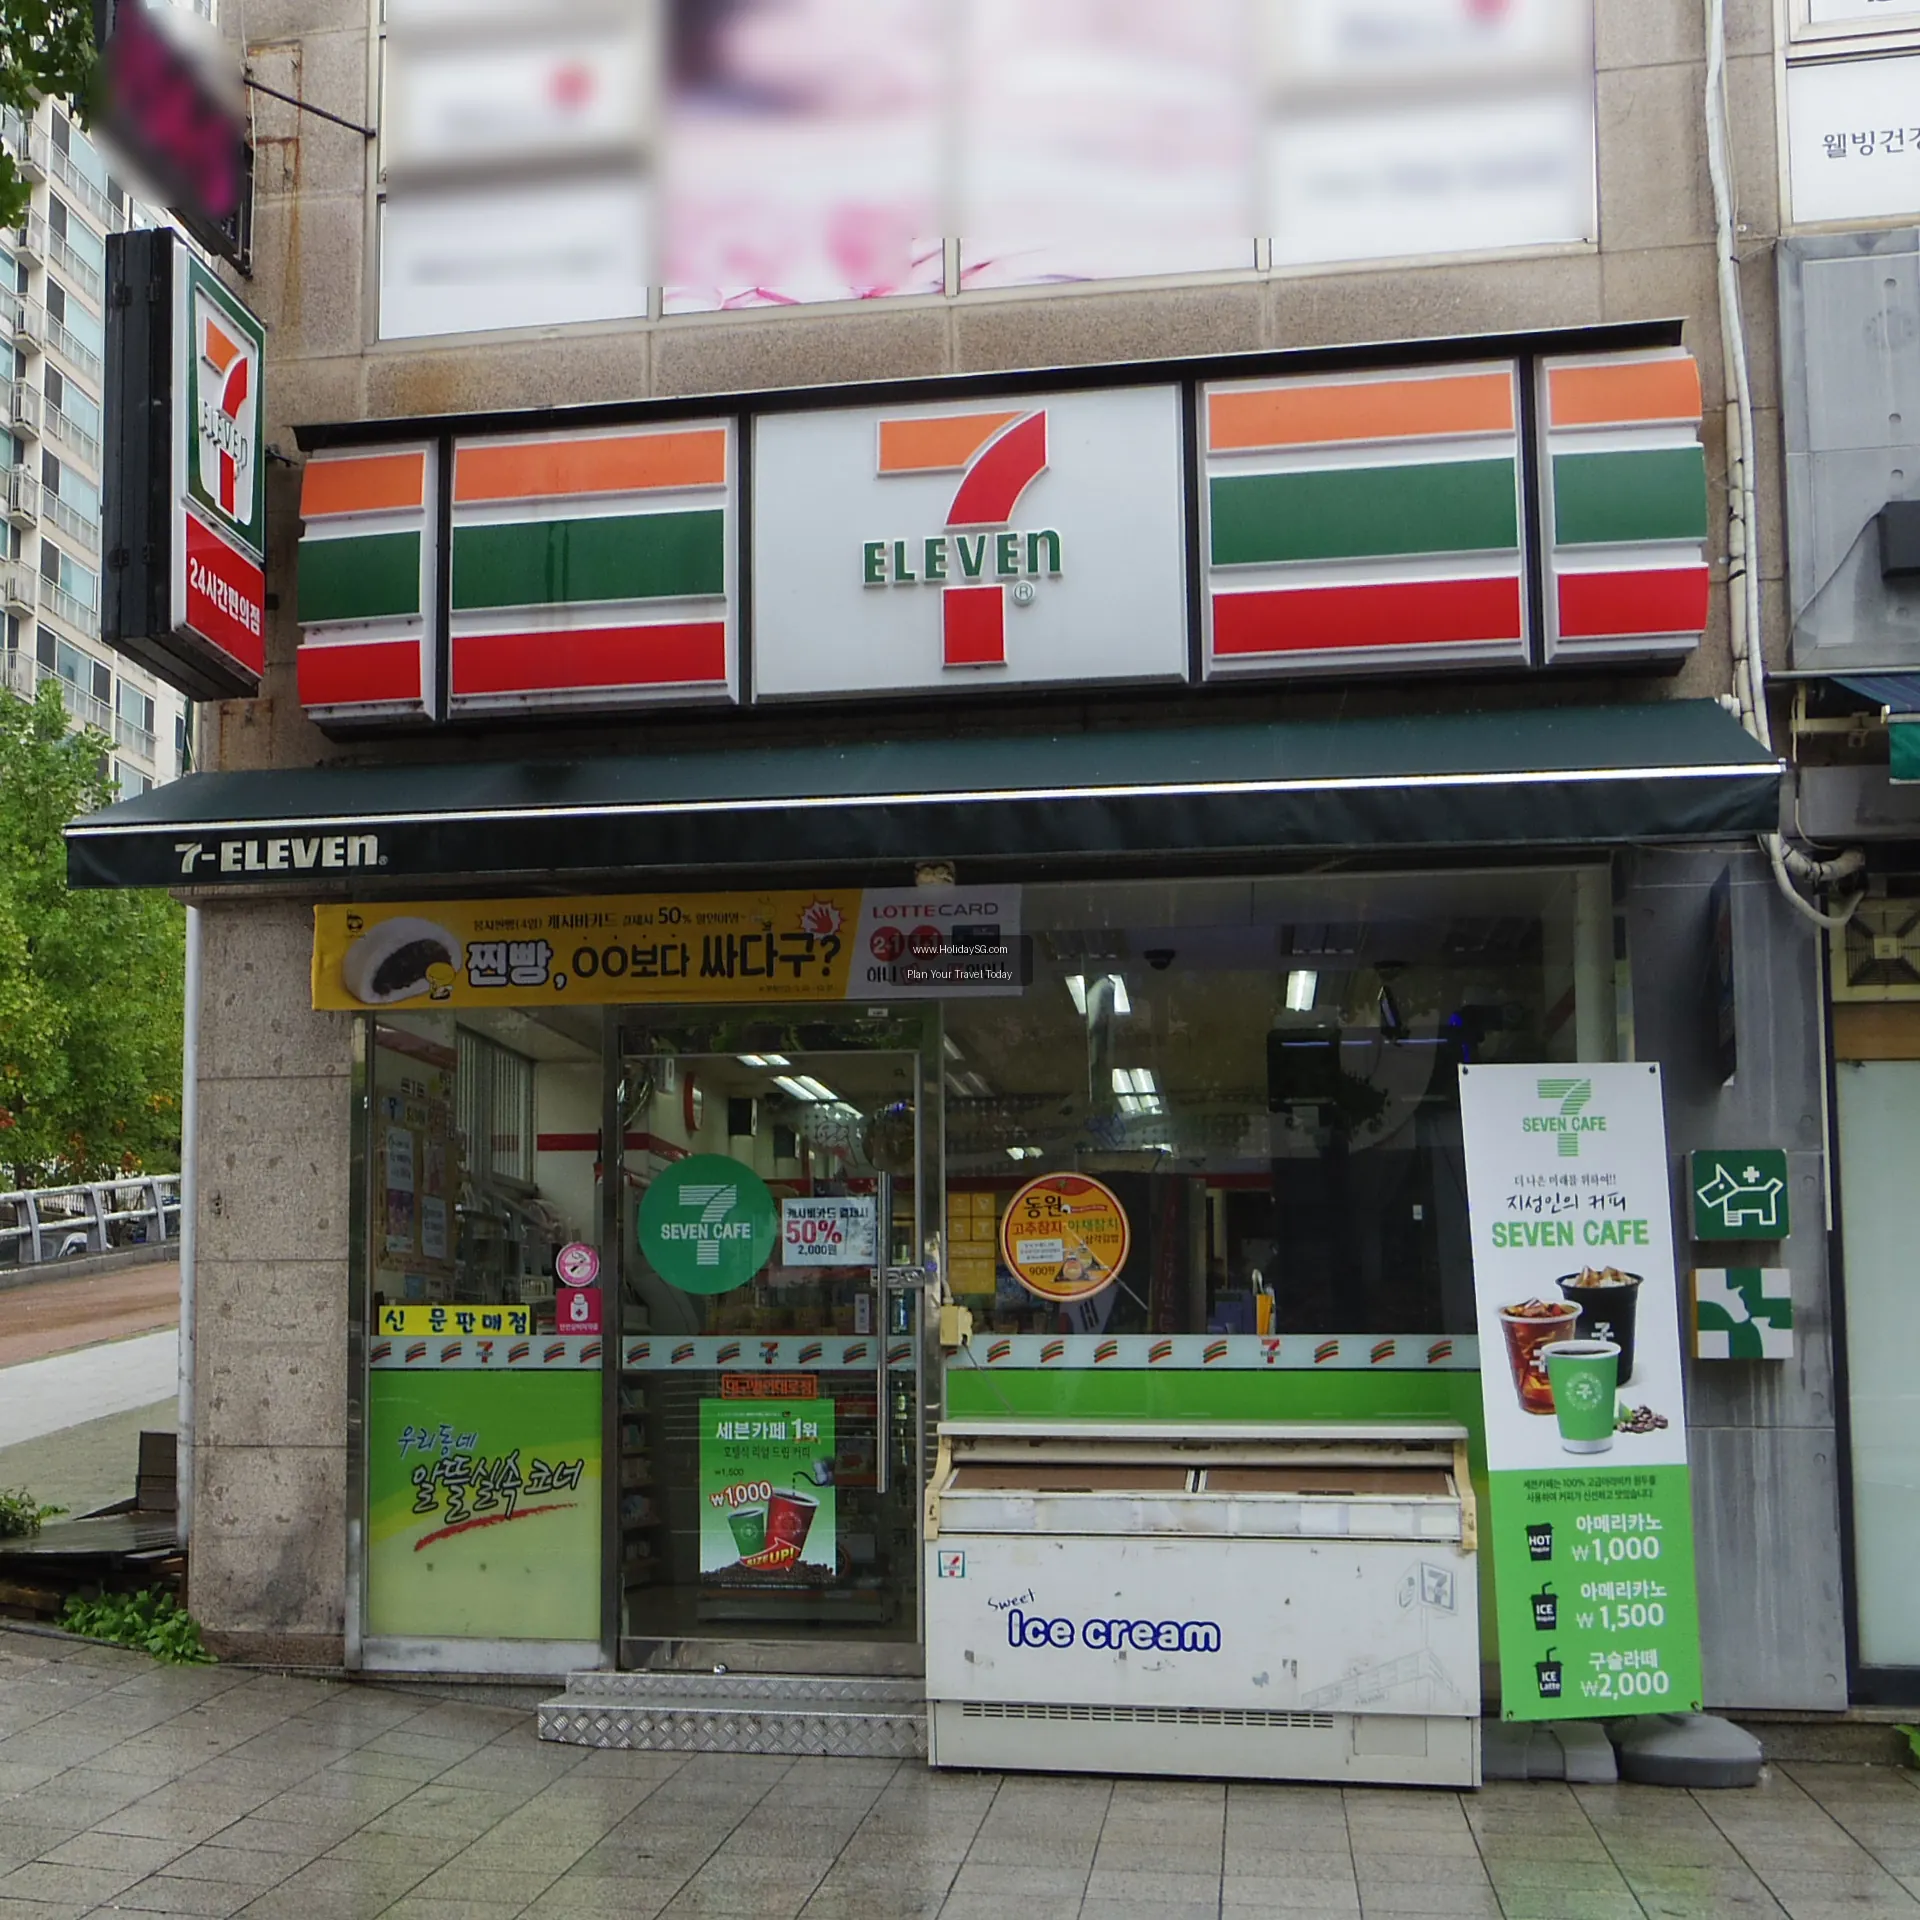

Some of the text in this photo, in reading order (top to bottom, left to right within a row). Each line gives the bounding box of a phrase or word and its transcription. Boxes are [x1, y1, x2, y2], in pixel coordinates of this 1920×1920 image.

[877, 410, 1049, 667] 7
[190, 557, 261, 637] 24시간편의점
[658, 906, 692, 925] 50%
[466, 938, 566, 991] 찐빵,
[700, 933, 841, 978] 싸다구?
[1522, 1116, 1606, 1133] SEVEN CAFE
[1024, 1196, 1062, 1219] 동원
[1507, 1191, 1626, 1214] 지성인의 커피
[661, 1222, 751, 1239] SEVEN CAFE
[787, 1219, 842, 1244] 50%
[1492, 1219, 1649, 1248] SEVEN CAFE
[798, 1244, 837, 1256] 2,000원
[716, 1417, 818, 1441] 세븐카페 1위
[398, 1424, 478, 1459] 우리동네
[1575, 1513, 1662, 1535] 아메리카노
[1529, 1535, 1552, 1546] HOT
[770, 1548, 795, 1564] UP!
[988, 1588, 1036, 1611] Sweet
[1580, 1579, 1667, 1602] 아메리카노
[1536, 1604, 1554, 1615] ICE
[1082, 1618, 1220, 1652] cream
[1588, 1649, 1658, 1671] 구슬라떼
[1540, 1682, 1561, 1691] Latte
[1542, 1671, 1557, 1682] ICE
